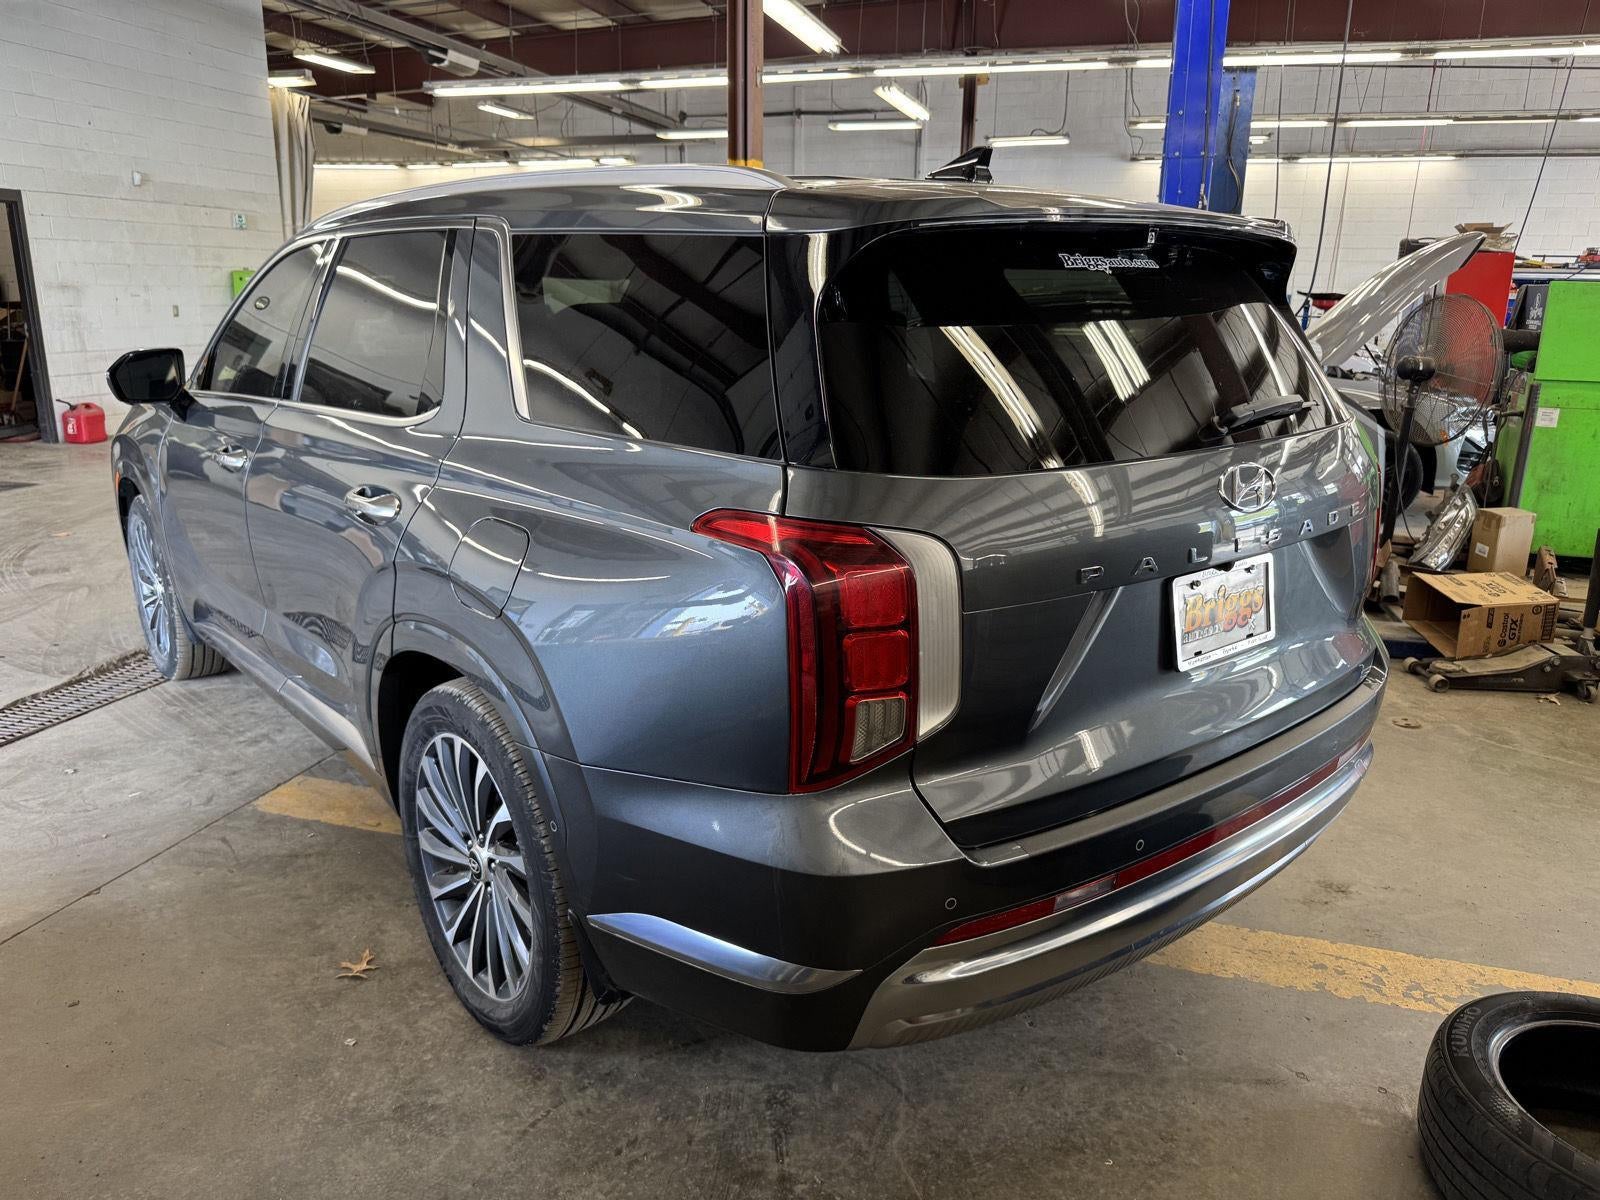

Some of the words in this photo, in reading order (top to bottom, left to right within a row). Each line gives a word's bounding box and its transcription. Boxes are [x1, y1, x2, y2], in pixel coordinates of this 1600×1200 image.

[1058, 252, 1160, 271] Briggsauto.com
[1080, 501, 1361, 585] PALISADE
[1184, 585, 1264, 633] Briggs
[1500, 613, 1509, 638] Castrol
[1509, 618, 1519, 640] GTX
[1451, 1007, 1481, 1056] KUMHO
